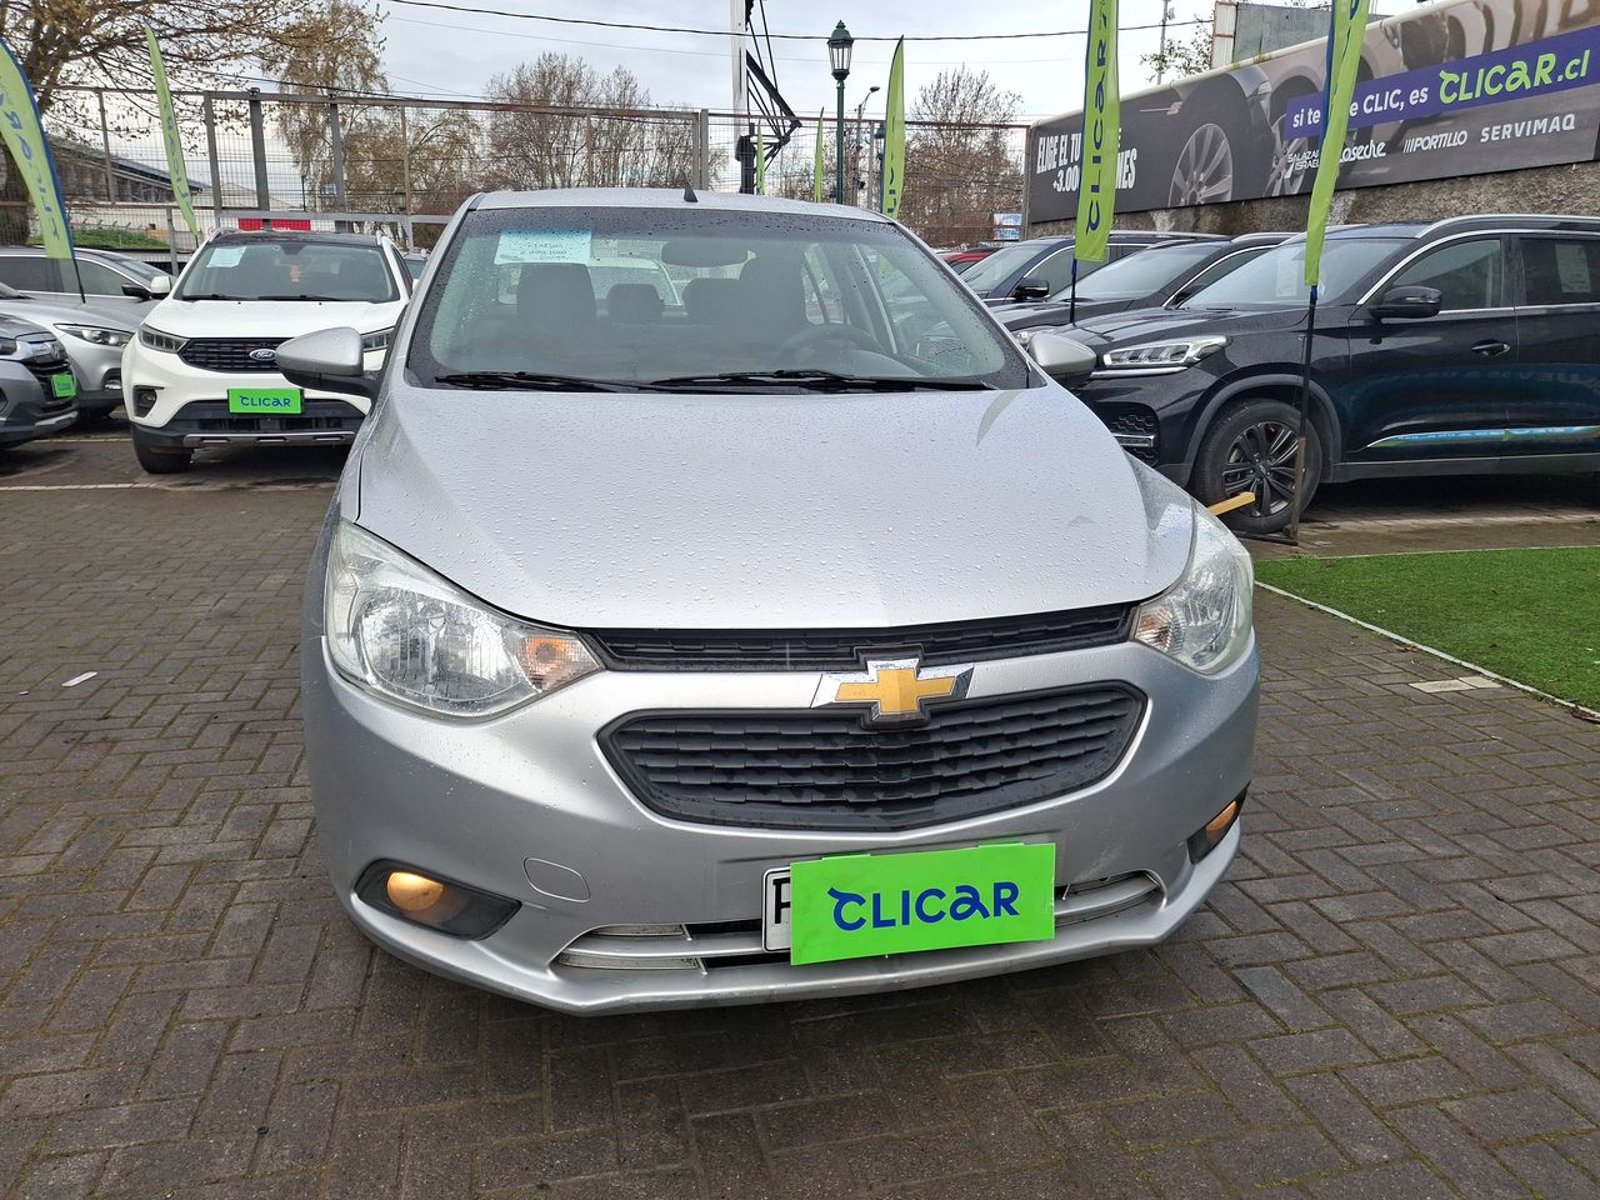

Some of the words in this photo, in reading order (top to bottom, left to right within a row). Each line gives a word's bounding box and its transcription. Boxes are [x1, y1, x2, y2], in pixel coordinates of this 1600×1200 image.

[1293, 113, 1303, 128] si
[1308, 108, 1321, 125] te
[1363, 90, 1404, 115] CLIC,
[1409, 87, 1429, 105] es
[1480, 114, 1576, 143] SERVIMAQ
[1058, 134, 1068, 167] EL
[1070, 133, 1082, 163] TU
[1052, 165, 1081, 192] +3.00
